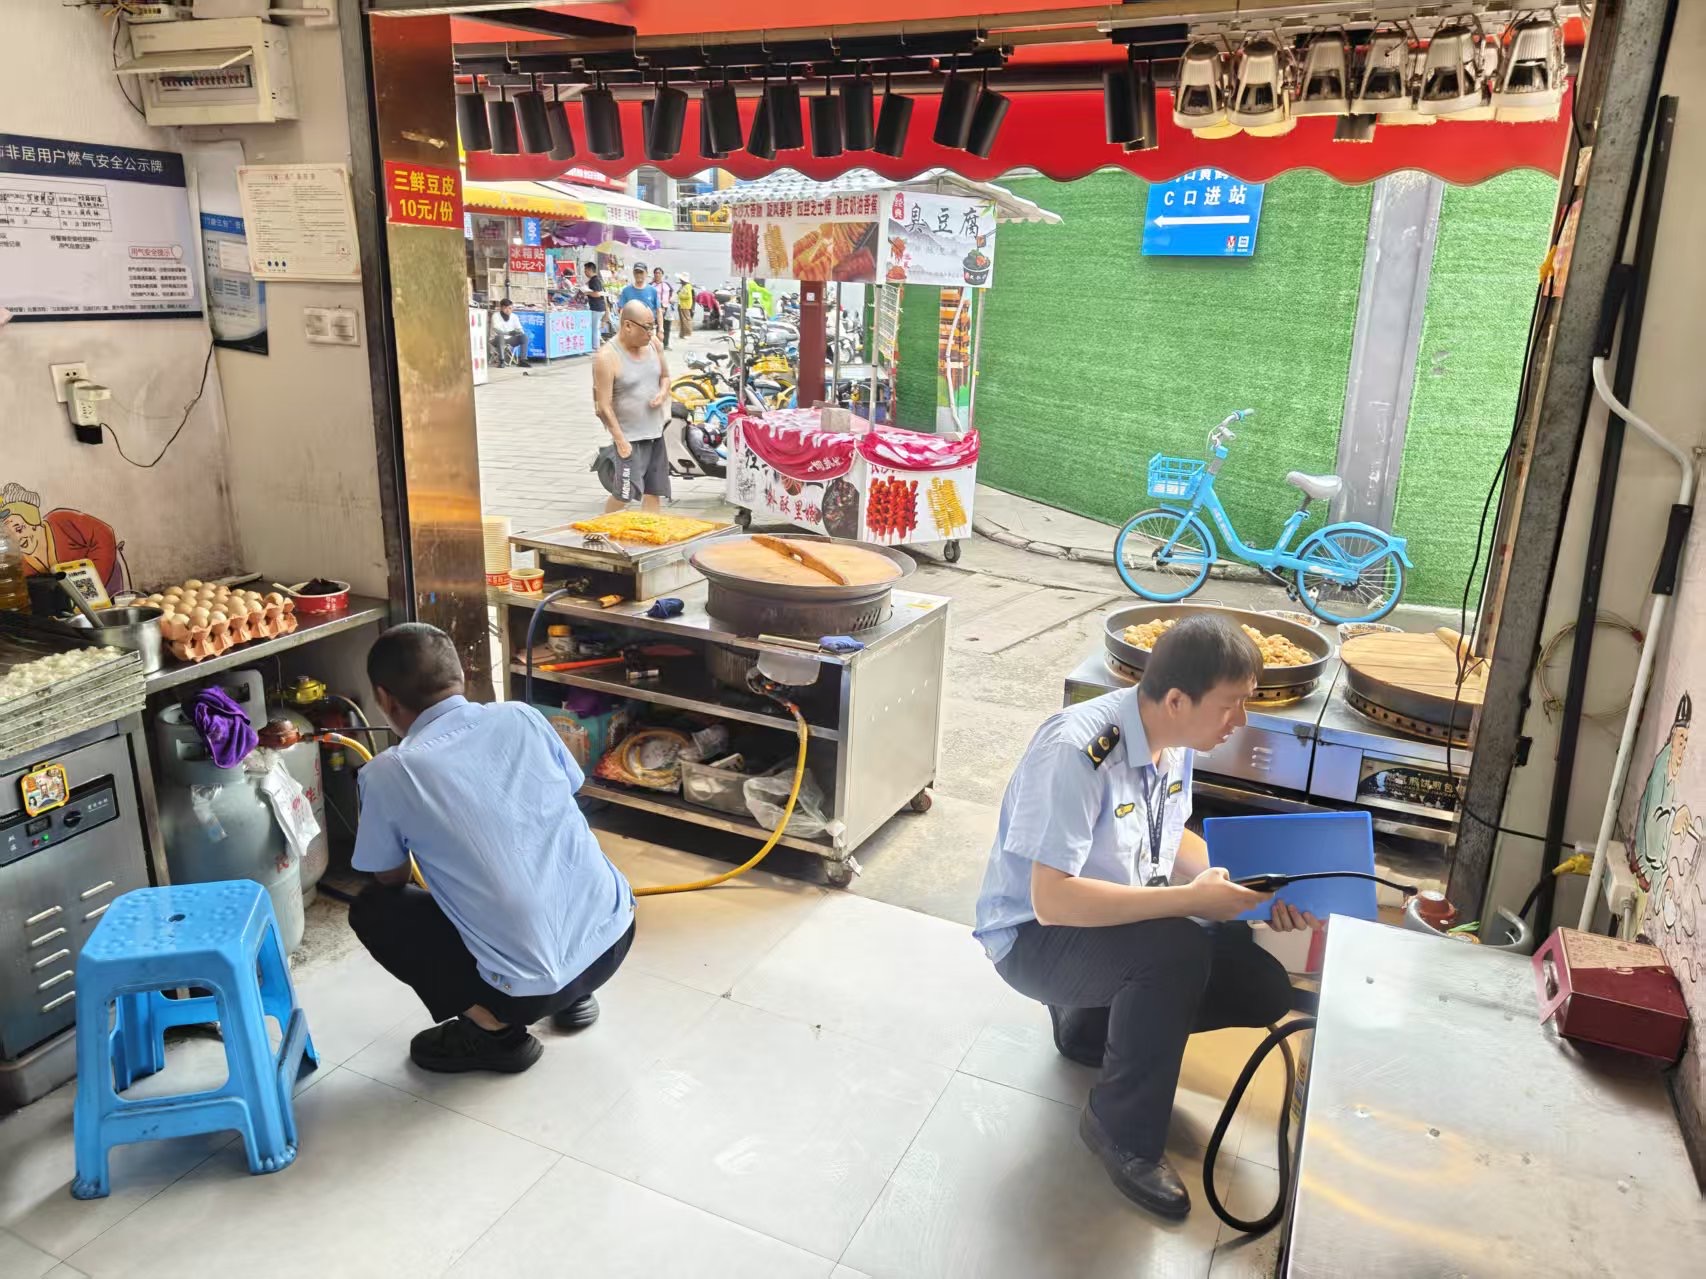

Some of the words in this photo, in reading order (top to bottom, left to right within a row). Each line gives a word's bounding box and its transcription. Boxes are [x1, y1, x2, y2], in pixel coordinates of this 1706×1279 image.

[394, 170, 456, 197] 三鲜豆皮
[400, 199, 453, 222] 10元/份
[905, 203, 980, 239] 臭豆腐
[511, 247, 544, 259] 冰箱贴
[511, 260, 544, 271] 10元2个
